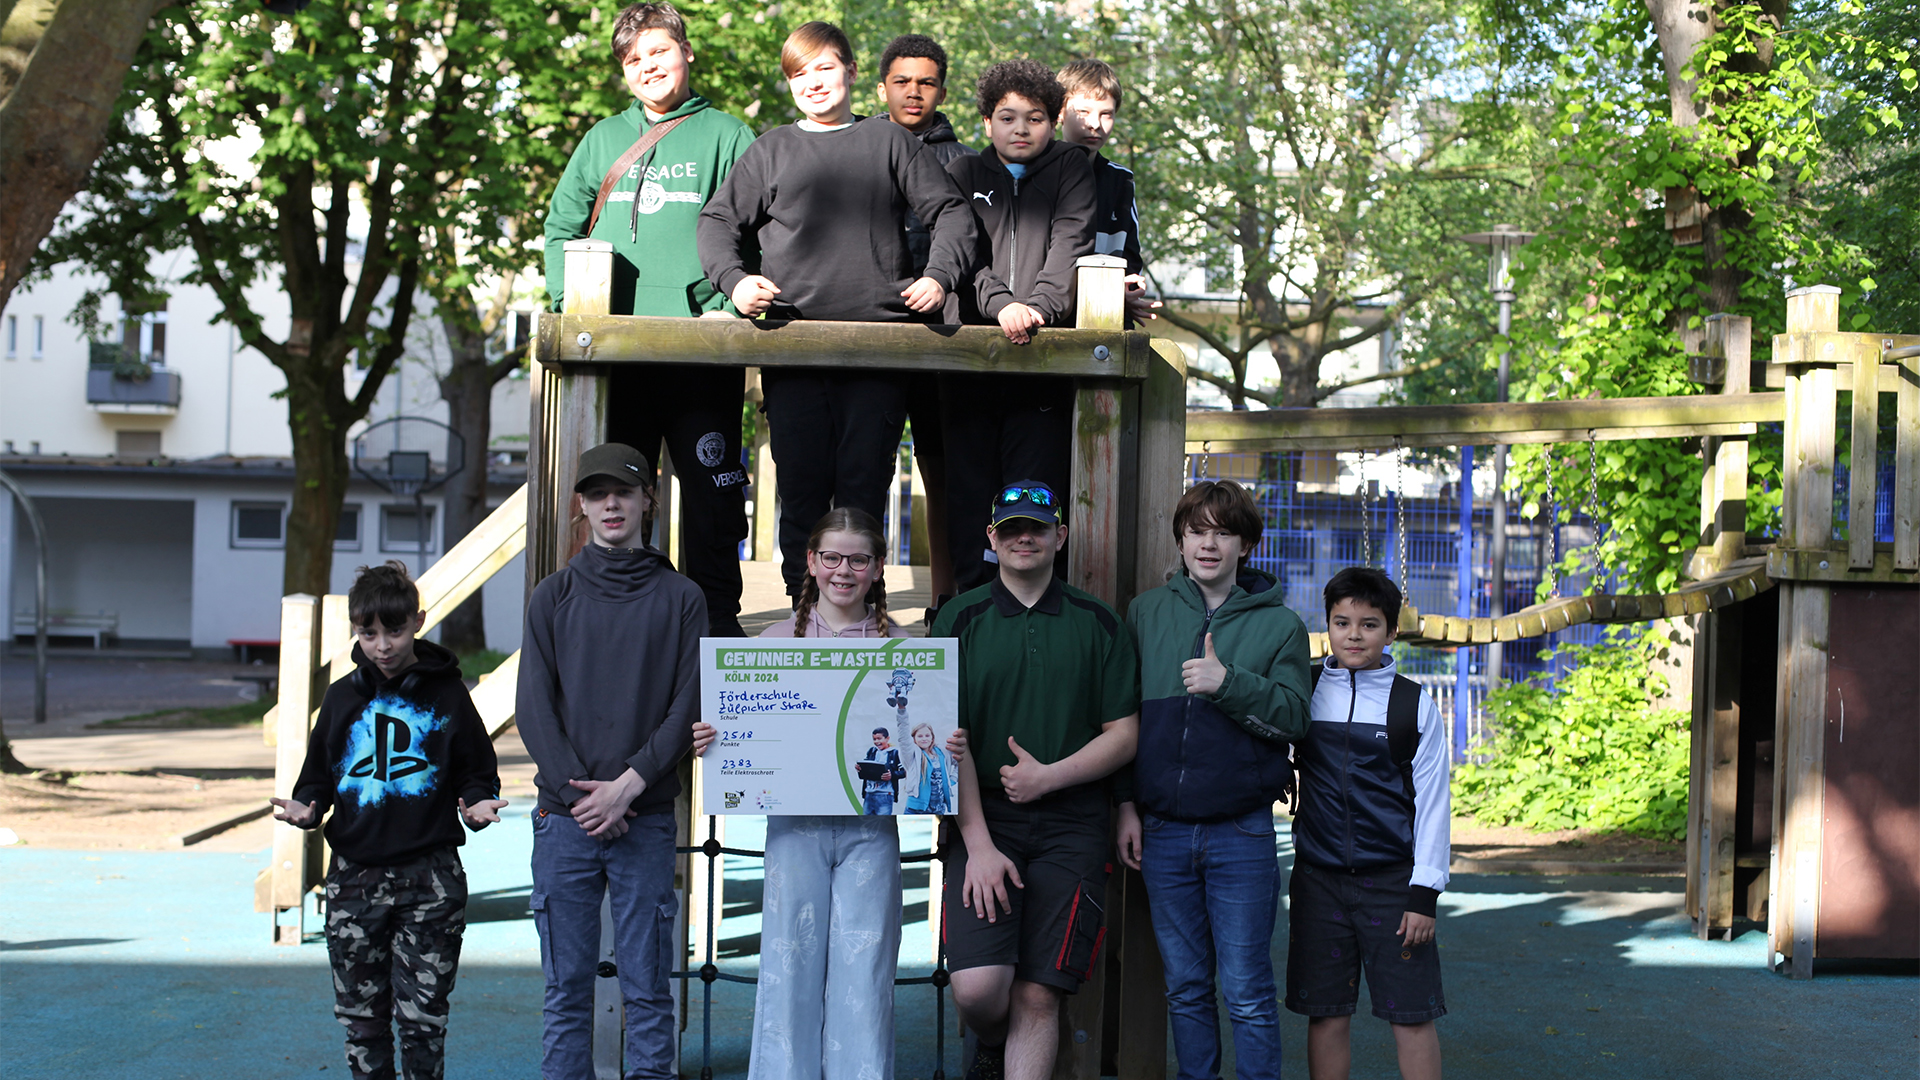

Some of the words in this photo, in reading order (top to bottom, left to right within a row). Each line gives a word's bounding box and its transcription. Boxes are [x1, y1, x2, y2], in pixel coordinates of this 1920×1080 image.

[723, 651, 805, 667] GEWINNER
[810, 651, 886, 667] E-WASTE
[892, 651, 937, 667] RACE
[724, 670, 751, 682] KÖLN
[754, 673, 779, 682] 2024
[719, 689, 800, 702] Förderschule
[722, 730, 753, 741] 2518
[722, 758, 752, 770] 2383
